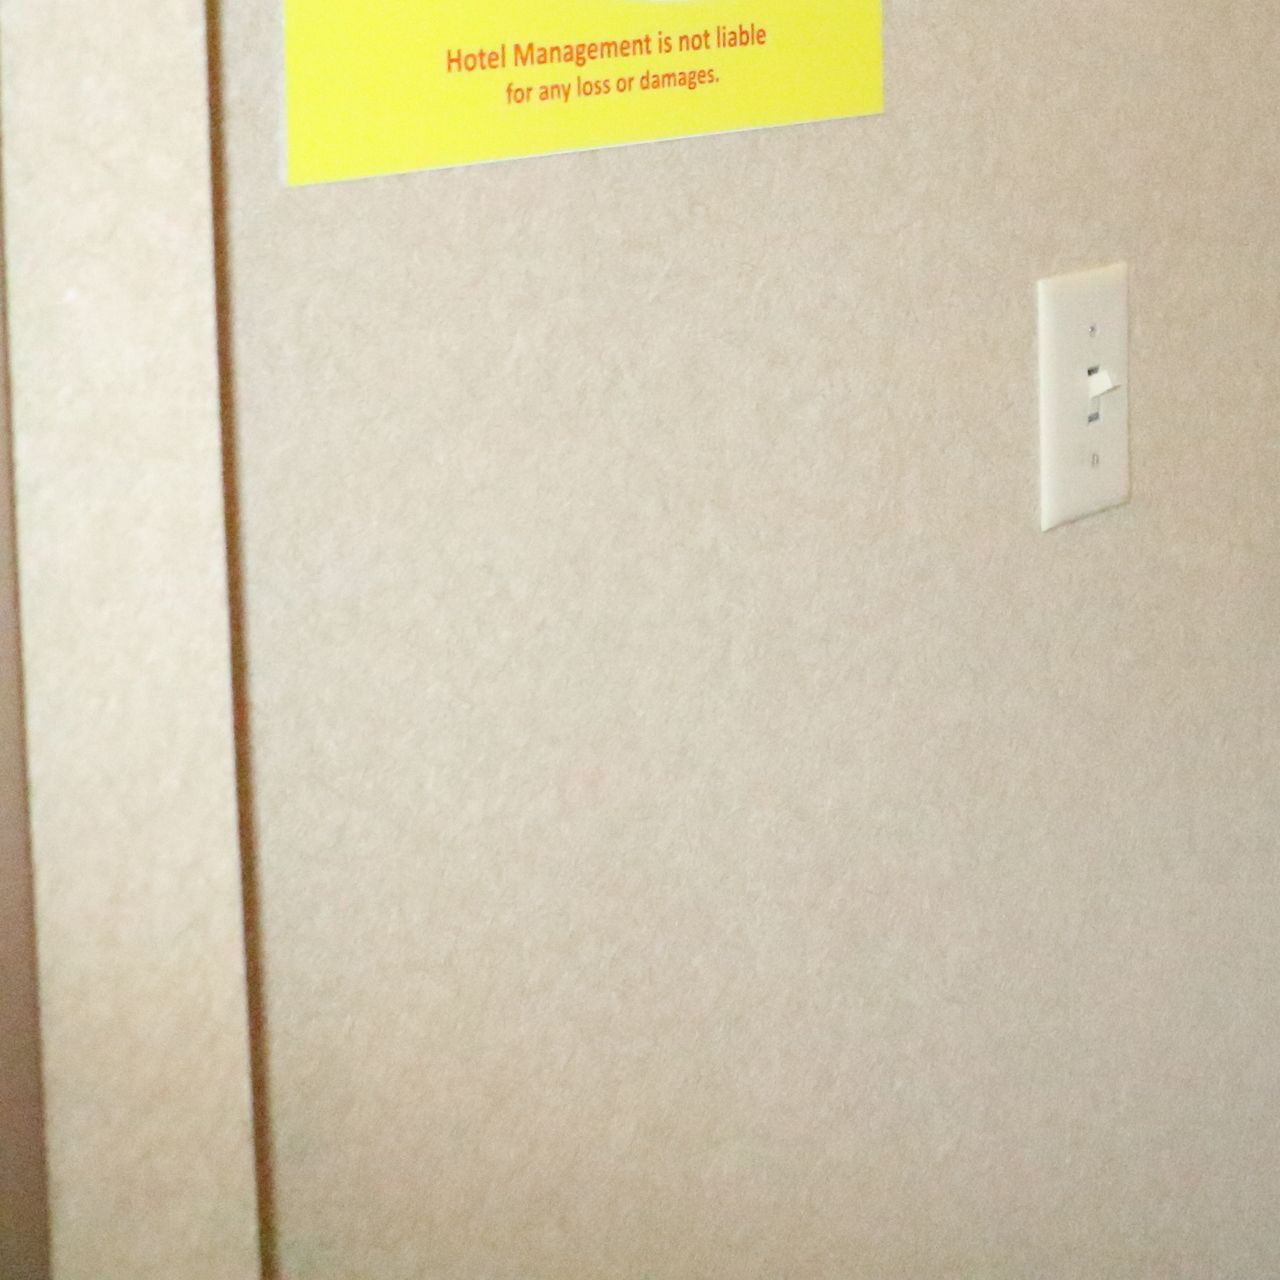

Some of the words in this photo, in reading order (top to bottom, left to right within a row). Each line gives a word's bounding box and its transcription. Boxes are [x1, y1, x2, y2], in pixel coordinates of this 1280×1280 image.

[447, 44, 506, 73] Hotel
[513, 35, 652, 68] Management
[658, 29, 673, 54] is
[679, 27, 710, 51] not
[717, 23, 767, 49] liable
[506, 80, 533, 104] for
[539, 83, 572, 103] any
[577, 75, 611, 97] loss
[616, 77, 635, 94] or
[640, 66, 720, 91] damages.
